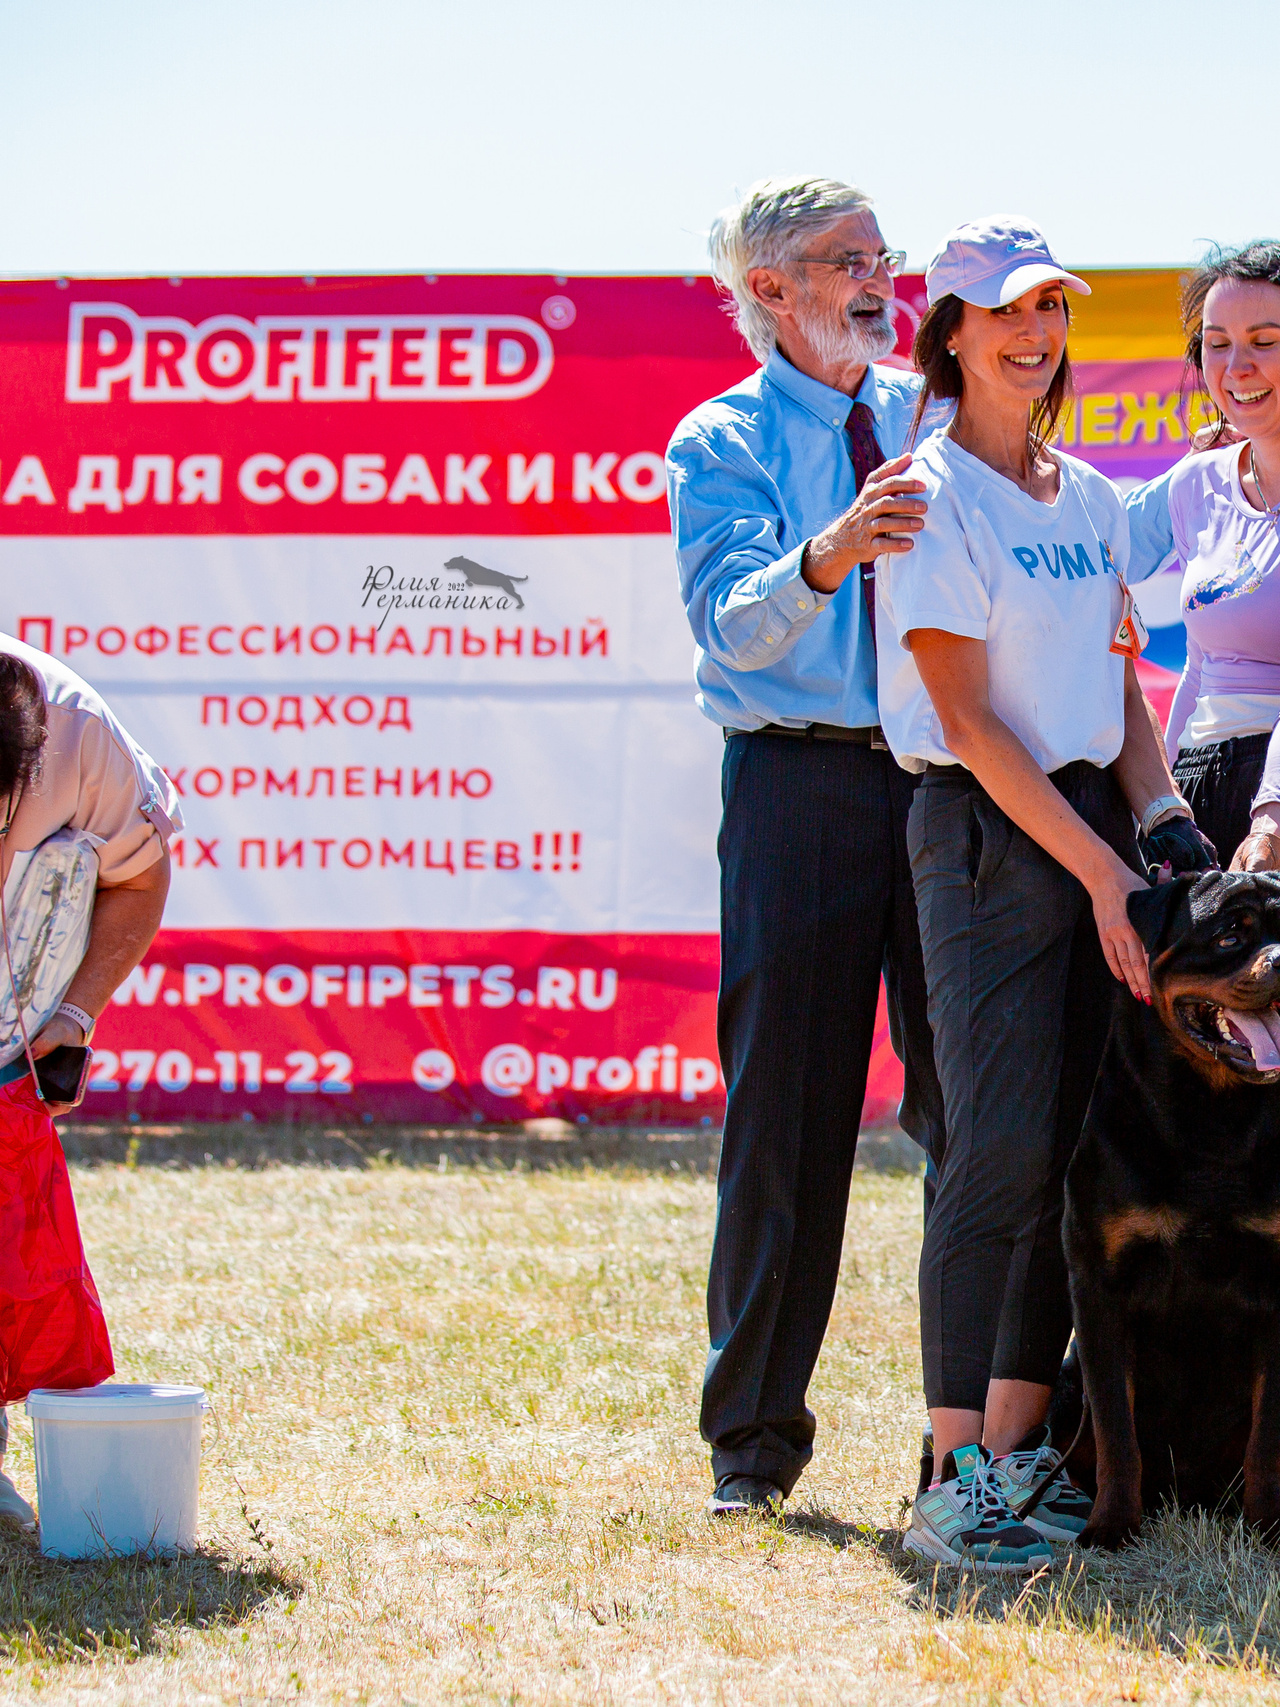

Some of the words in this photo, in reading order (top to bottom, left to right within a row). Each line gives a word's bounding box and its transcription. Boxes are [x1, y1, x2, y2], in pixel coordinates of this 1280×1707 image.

[67, 303, 554, 403] PROFIFEED
[0, 454, 57, 505] А
[67, 453, 222, 514] ДЛЯ
[237, 451, 492, 504] СОБАК
[506, 452, 557, 504] И
[1011, 540, 1118, 580] PUMA
[201, 694, 412, 732] ПОДХОД
[481, 1042, 726, 1103] @profip
